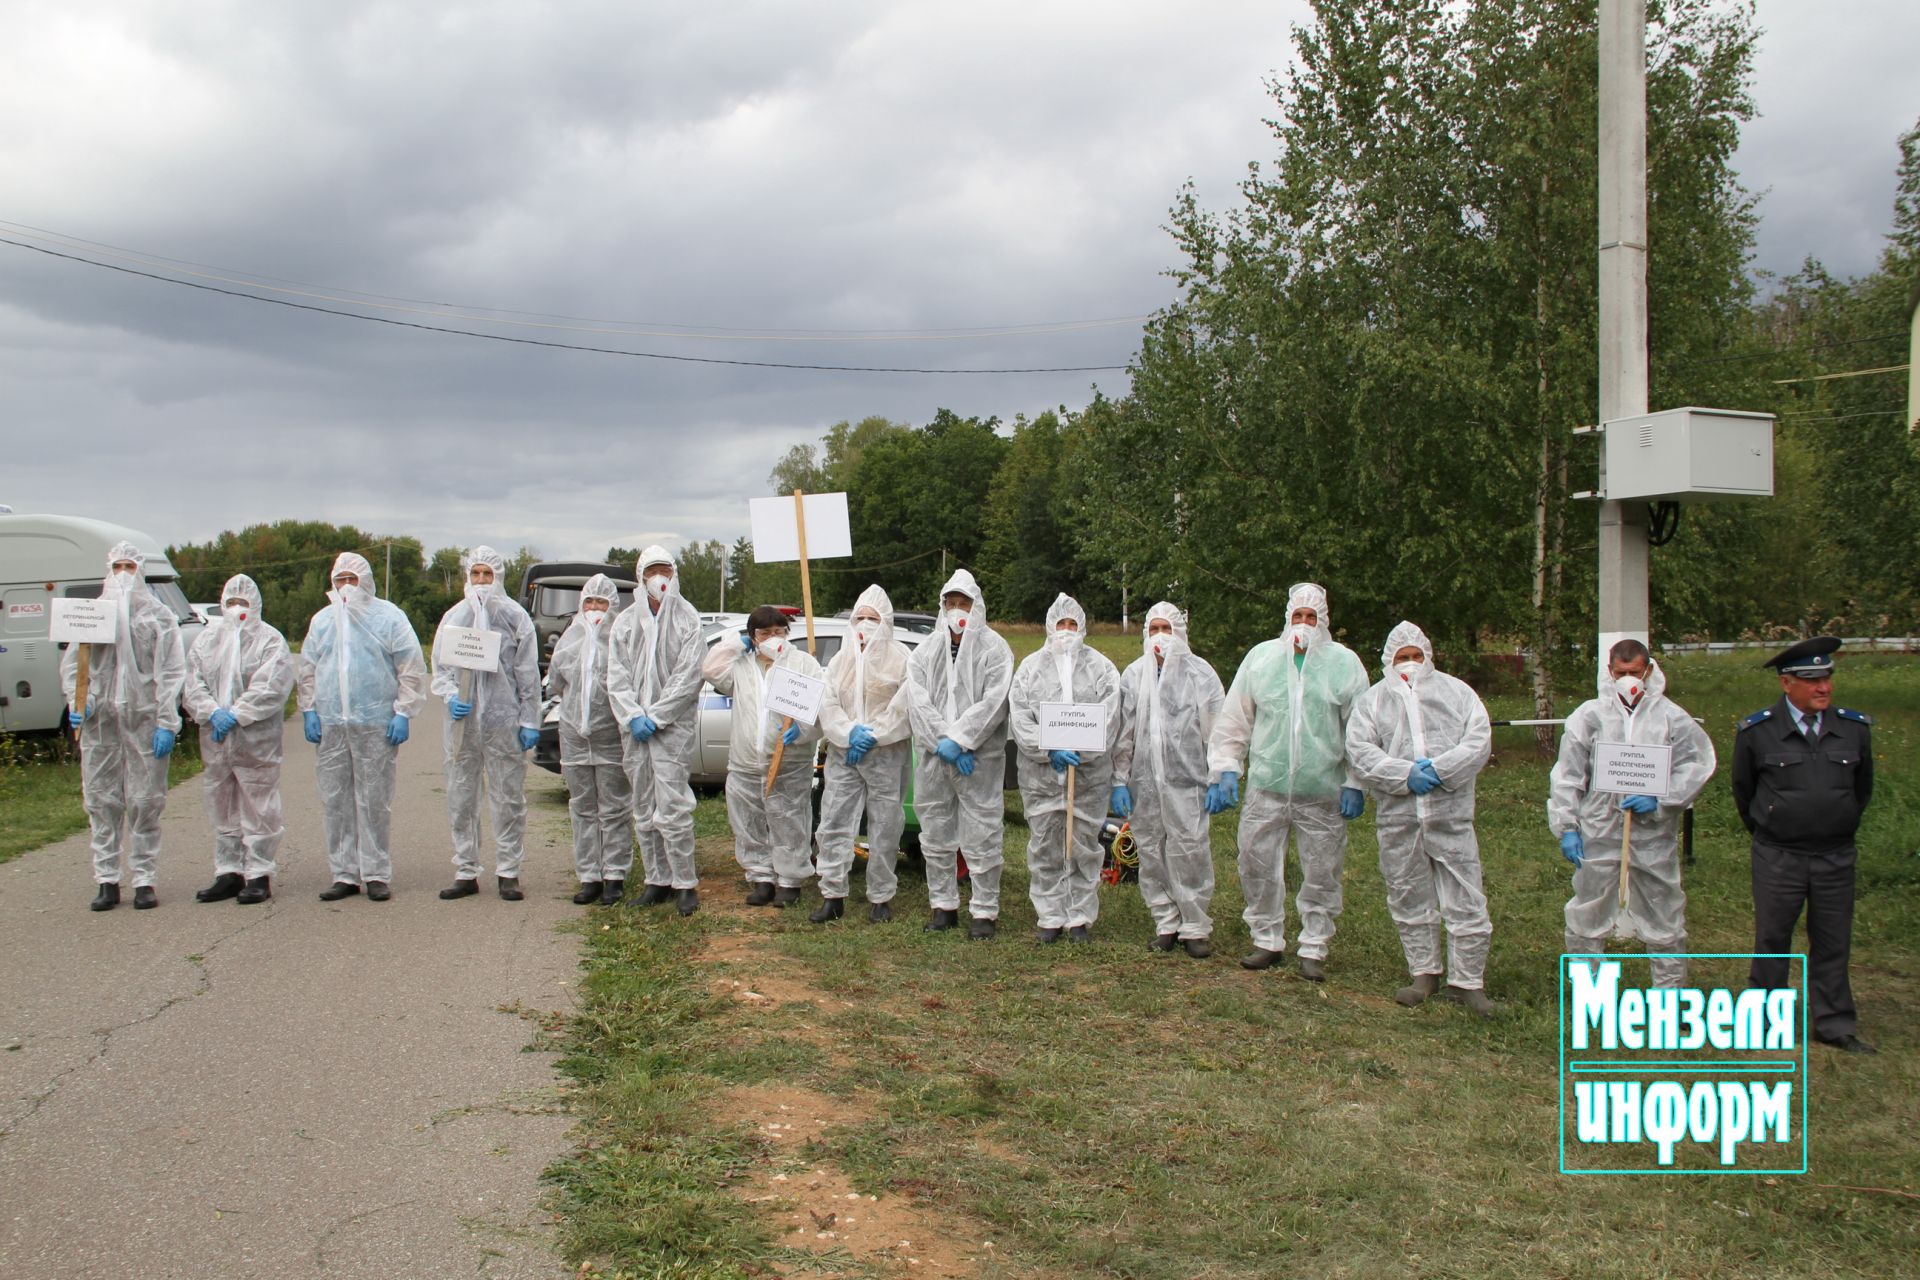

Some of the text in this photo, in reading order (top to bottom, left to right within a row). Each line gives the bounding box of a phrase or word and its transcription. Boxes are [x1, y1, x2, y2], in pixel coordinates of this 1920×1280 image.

[788, 678, 808, 689] ГРУППА
[775, 695, 810, 712] УТИЛИЗАЦИИ
[1048, 720, 1097, 728] ДЕЗИНФЕКЦИИ
[1609, 760, 1656, 769] ОБЕСПЕЧЕНИЯ
[1607, 770, 1656, 779] ПРОПУСКНОГО
